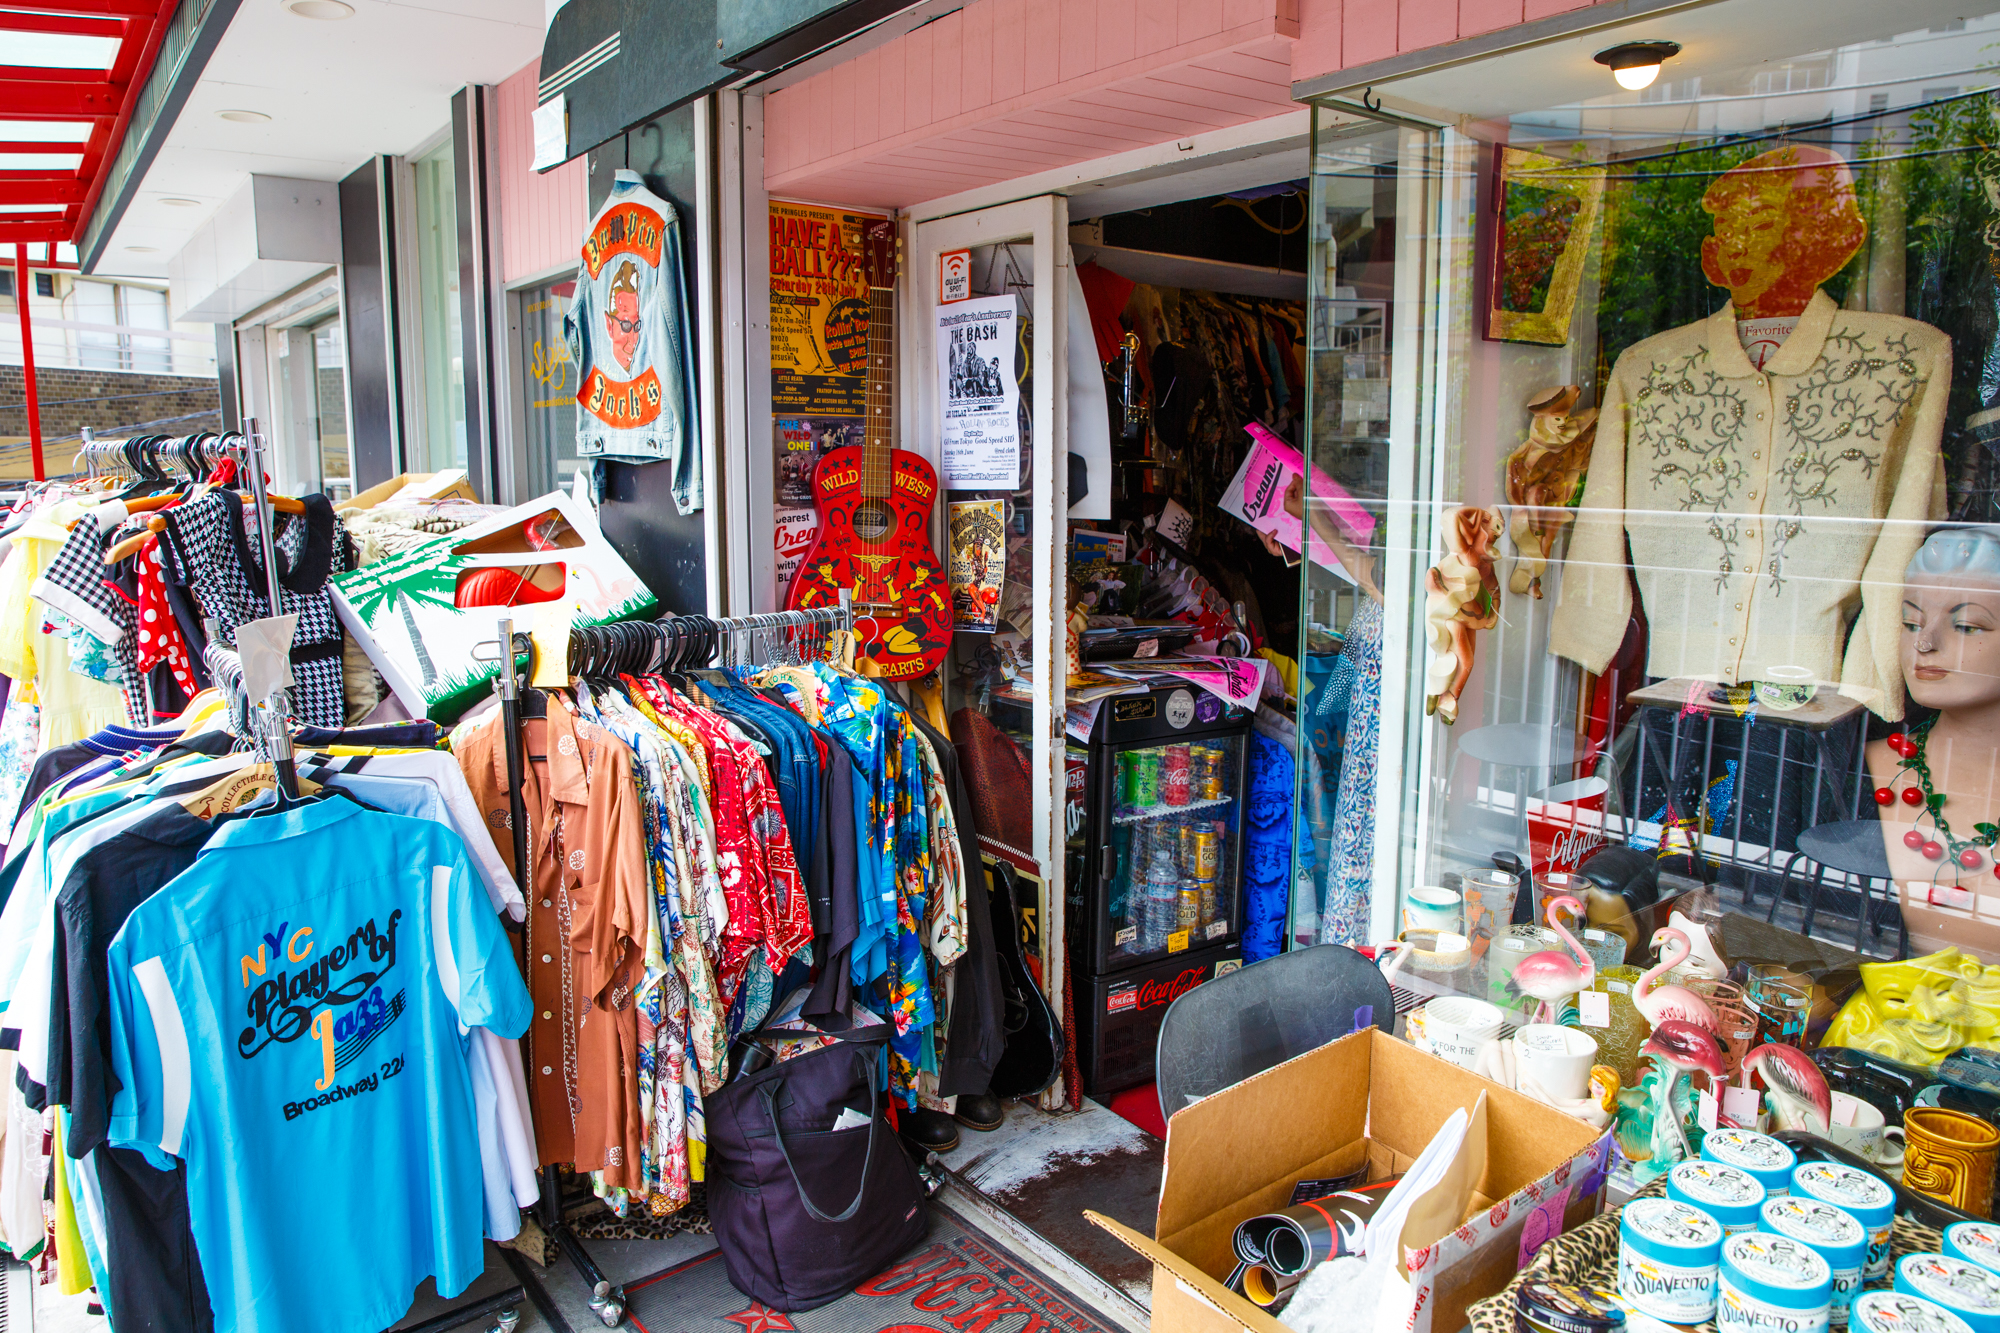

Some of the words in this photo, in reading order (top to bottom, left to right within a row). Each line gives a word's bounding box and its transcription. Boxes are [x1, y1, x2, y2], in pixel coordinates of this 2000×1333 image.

[769, 206, 779, 214] THE
[781, 208, 807, 217] PRINGLES
[809, 211, 834, 221] PRESENTS
[769, 215, 826, 251] HAVE
[828, 223, 842, 252] A
[769, 244, 863, 282] BALL???
[769, 277, 812, 295] Saturday
[815, 280, 835, 295] 28th
[949, 285, 962, 293] SPOT
[855, 335, 865, 345] The
[950, 328, 963, 344] THE
[966, 325, 997, 342] BASH
[1745, 324, 1793, 337] Favorite
[848, 346, 866, 359] SPIKE
[838, 362, 851, 373] THE
[589, 374, 661, 420] Jack's
[778, 420, 799, 430] THE
[783, 431, 811, 441] WILD
[988, 436, 1003, 445] Speed
[821, 469, 859, 493] WILD
[894, 471, 932, 498] WEST
[1242, 462, 1277, 522] Cream
[774, 525, 818, 550] Crea
[835, 536, 851, 547] BANG
[900, 540, 915, 549] BANG
[777, 560, 796, 570] with
[345, 580, 381, 598] Pink
[378, 554, 450, 586] Flamingos
[884, 657, 924, 678] EARTS
[221, 773, 267, 813] COLLECTIBLE
[241, 921, 314, 988] NYC
[1137, 965, 1207, 1011] Coca-Cola
[311, 986, 386, 1091] Jazz
[1439, 1041, 1456, 1054] FOR
[1459, 1046, 1476, 1056] THE
[1524, 1049, 1531, 1059] 2
[283, 1072, 378, 1121] Broadway
[959, 1238, 1007, 1274] THE
[1008, 1274, 1102, 1333] ORIGIN
[1634, 1270, 1710, 1295] SUAVECITO
[1550, 1317, 1593, 1333] SUAVECITO
[1721, 1297, 1798, 1333] SUAVECITO
